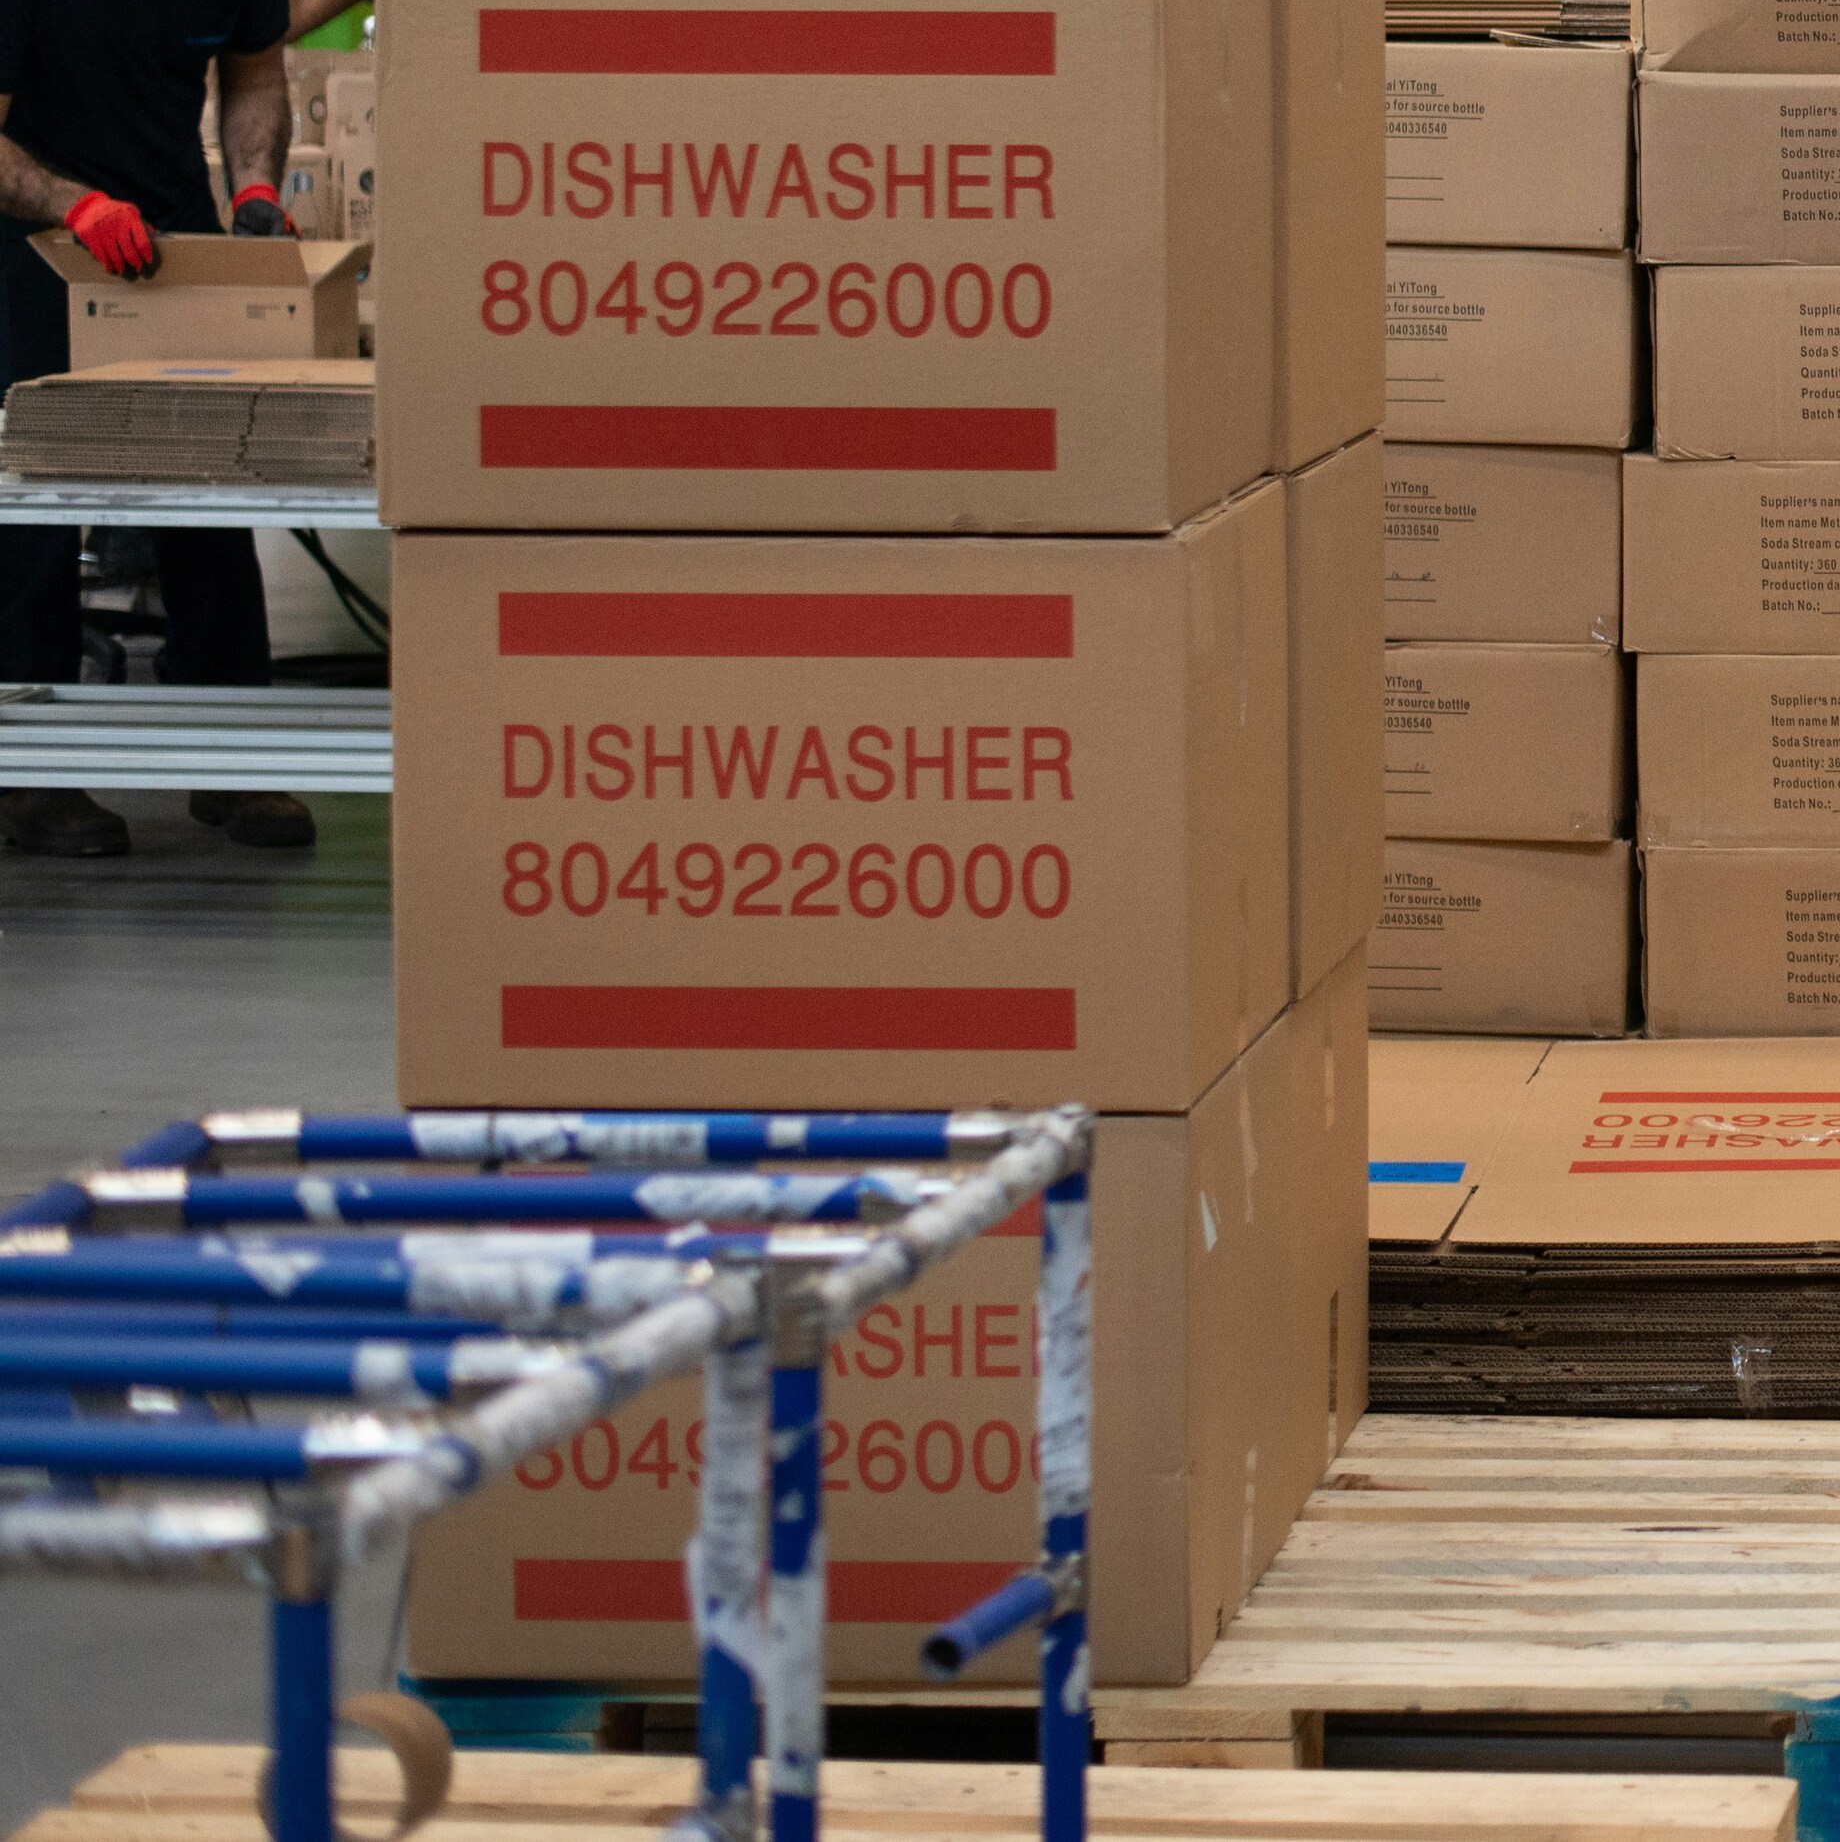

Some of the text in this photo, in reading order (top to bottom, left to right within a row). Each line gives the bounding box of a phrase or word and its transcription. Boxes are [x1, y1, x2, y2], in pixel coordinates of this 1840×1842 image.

[1776, 11, 1839, 22] Production
[1777, 31, 1836, 42] Batch No.:
[1398, 79, 1438, 94] YiTong
[1392, 99, 1486, 115] for source bottle
[1779, 105, 1839, 119] Supplier's
[1780, 126, 1805, 138] Item
[1807, 128, 1838, 137] name
[1780, 147, 1810, 159] Soda
[483, 141, 1055, 221] DISHWASHER
[1781, 168, 1835, 182] Quantity:
[1783, 210, 1816, 221] Batch
[1398, 281, 1438, 295] YiTong
[481, 259, 1052, 339] 8049226000
[1393, 301, 1486, 316] for source bottle
[1799, 324, 1824, 337] Item
[1800, 345, 1830, 358] Soda
[1801, 408, 1835, 420] Batch
[1390, 481, 1429, 495] YiTong
[1384, 501, 1478, 516] for source bottle
[1760, 495, 1819, 511] Supplier's
[1760, 516, 1785, 528] Item
[1787, 518, 1818, 528] name
[1384, 524, 1439, 536] 40336540
[1760, 536, 1790, 549] Soda
[1791, 537, 1832, 549] Stream
[1760, 558, 1815, 573] Quantity:
[1817, 558, 1838, 570] 360
[1761, 578, 1825, 591] Production
[1762, 599, 1821, 611] Batch No.:
[503, 723, 1073, 802] DISHWASHER
[502, 841, 1071, 920] 8049226000
